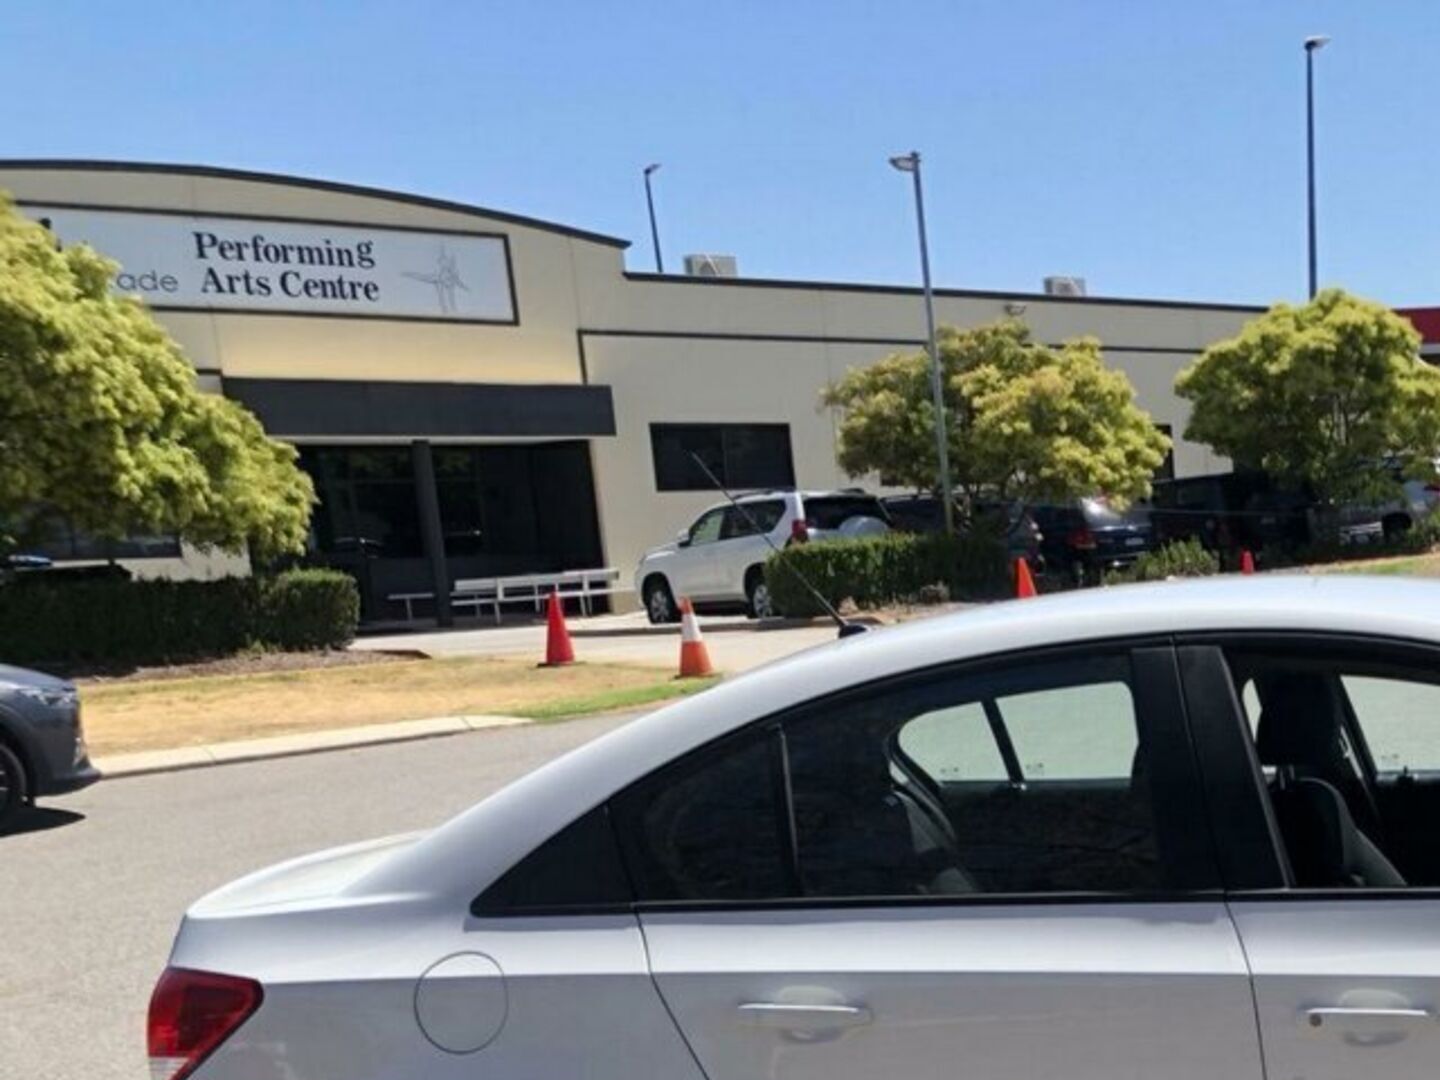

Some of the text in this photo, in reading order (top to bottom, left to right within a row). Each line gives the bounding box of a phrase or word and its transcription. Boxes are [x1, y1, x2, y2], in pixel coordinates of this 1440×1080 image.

[192, 231, 376, 269] Performing
[115, 268, 179, 294] ade
[201, 267, 379, 301] Arts Centre
